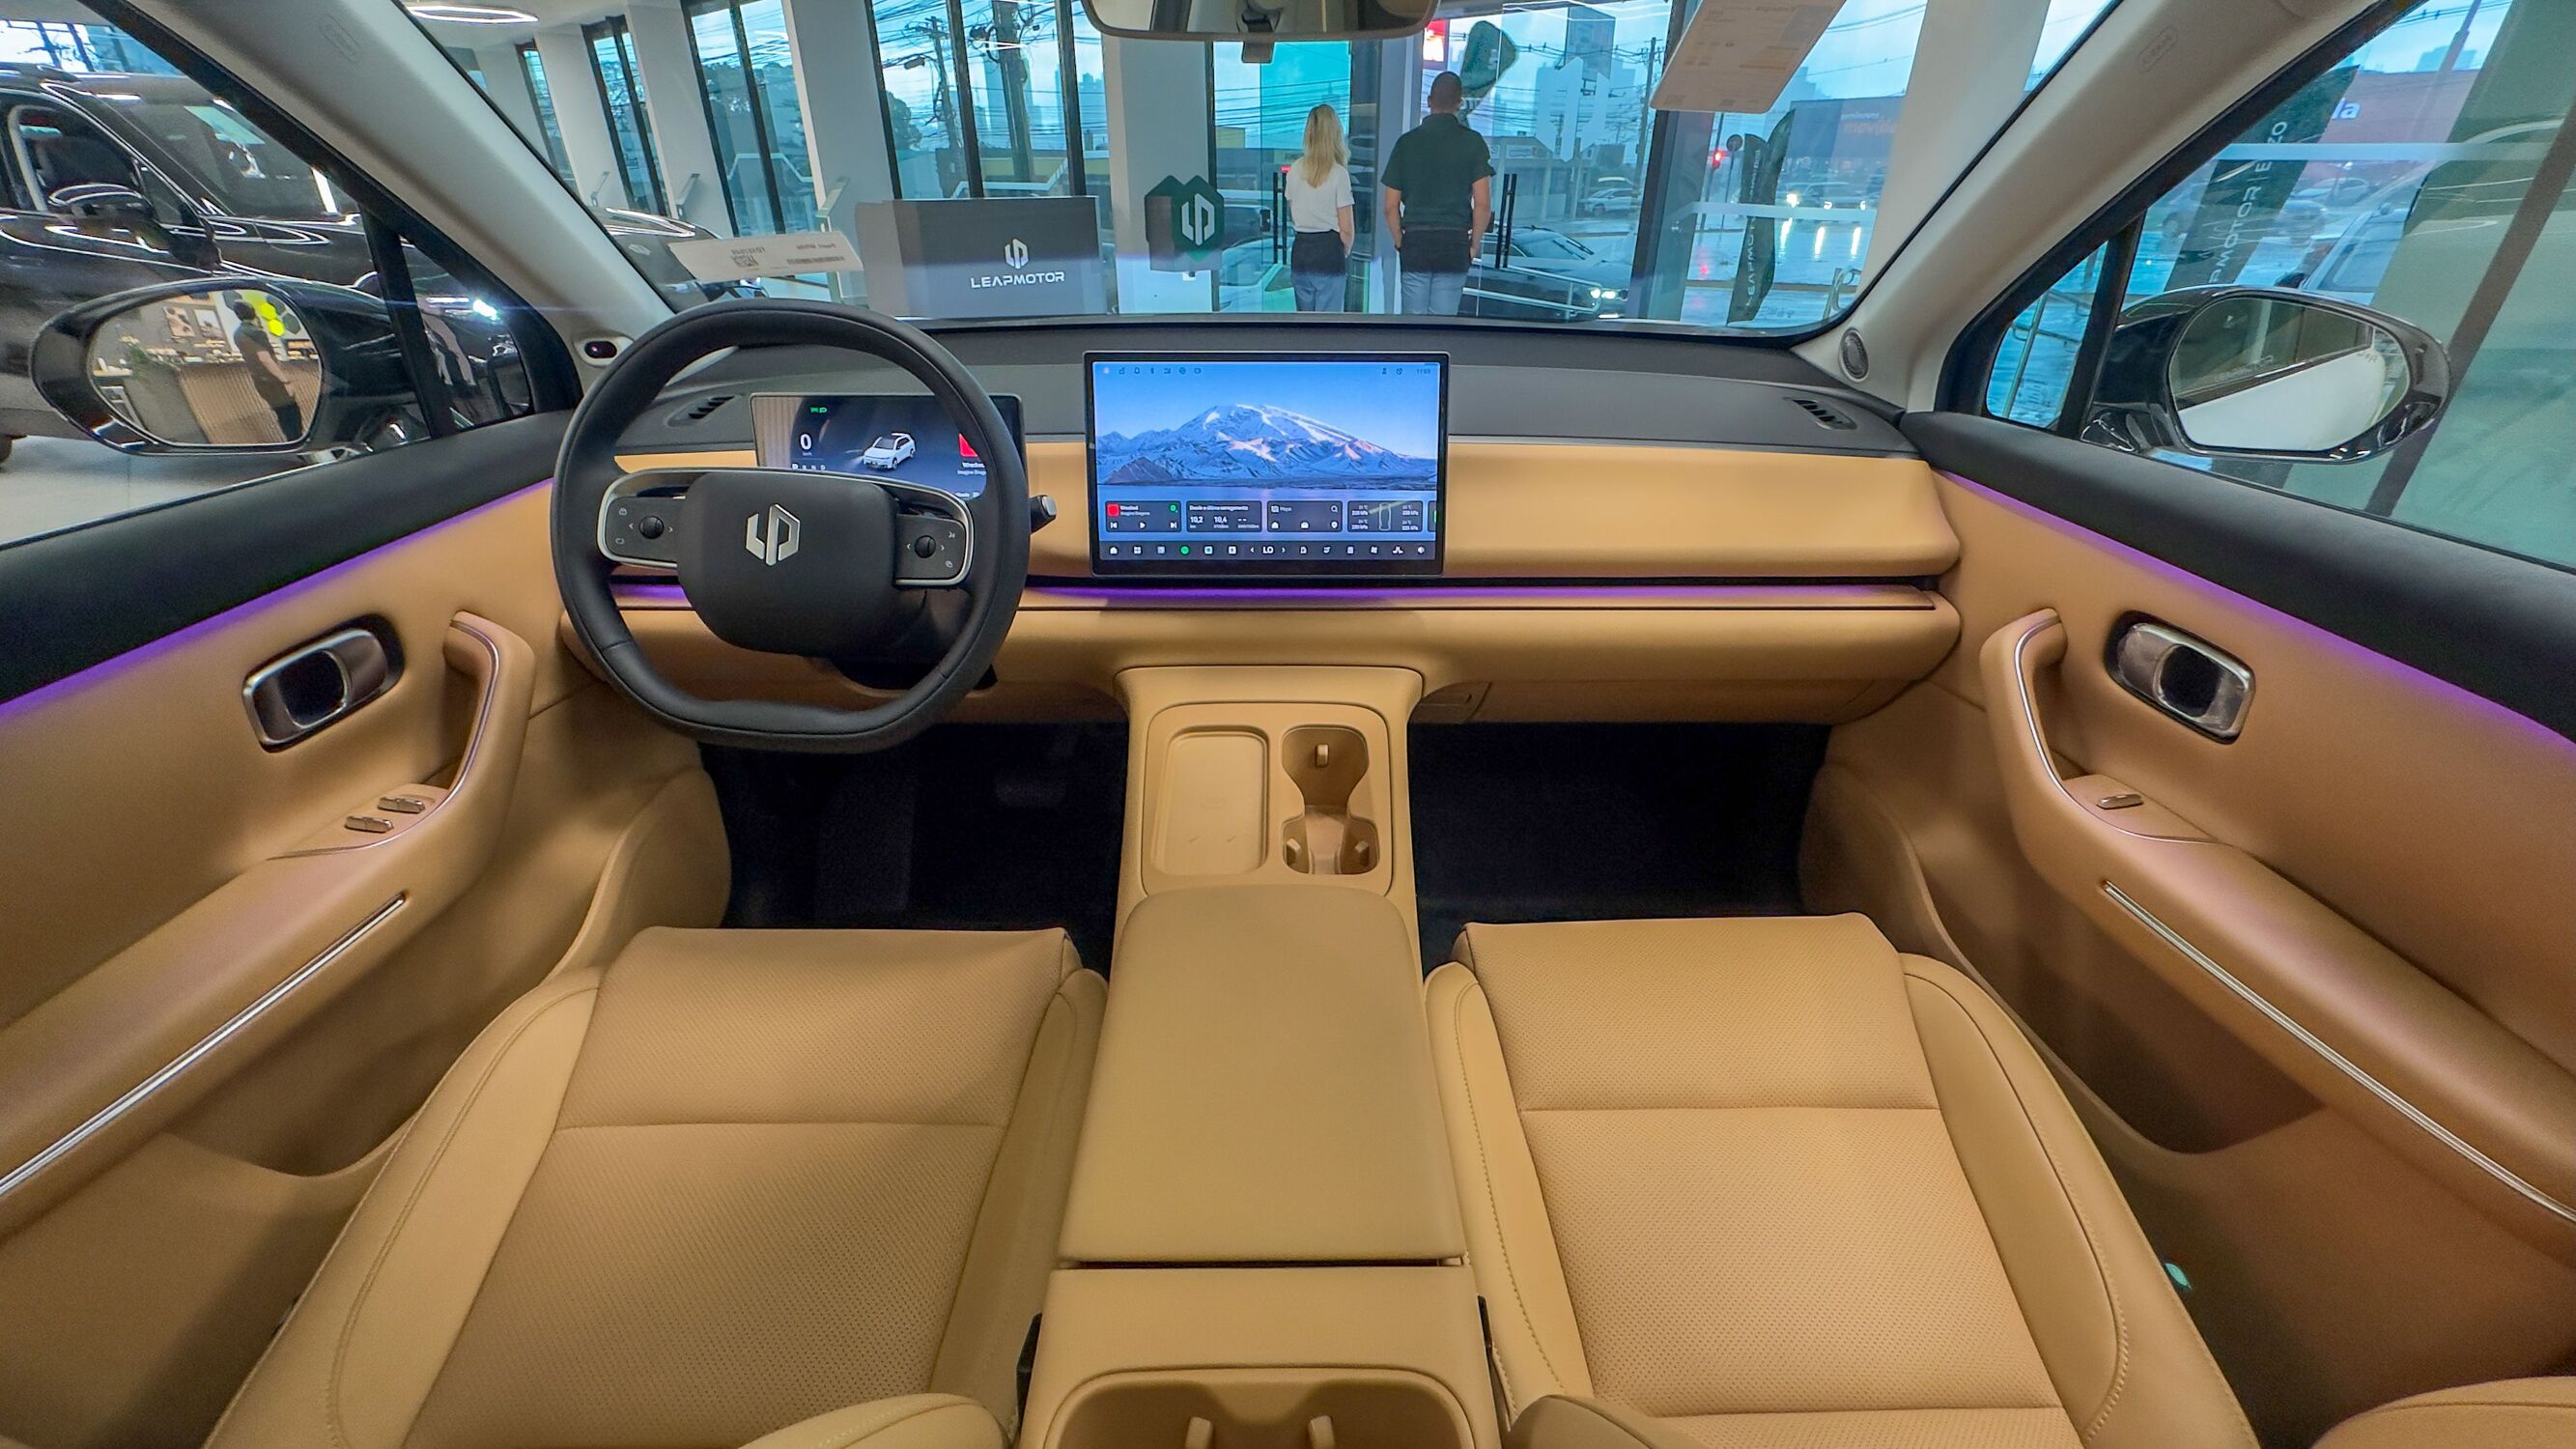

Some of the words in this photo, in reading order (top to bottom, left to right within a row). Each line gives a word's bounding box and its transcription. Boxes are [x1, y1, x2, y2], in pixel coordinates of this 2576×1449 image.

[970, 270, 1065, 289] LEAPMOTOR
[800, 433, 812, 450] 0
[1262, 546, 1274, 554] LO
